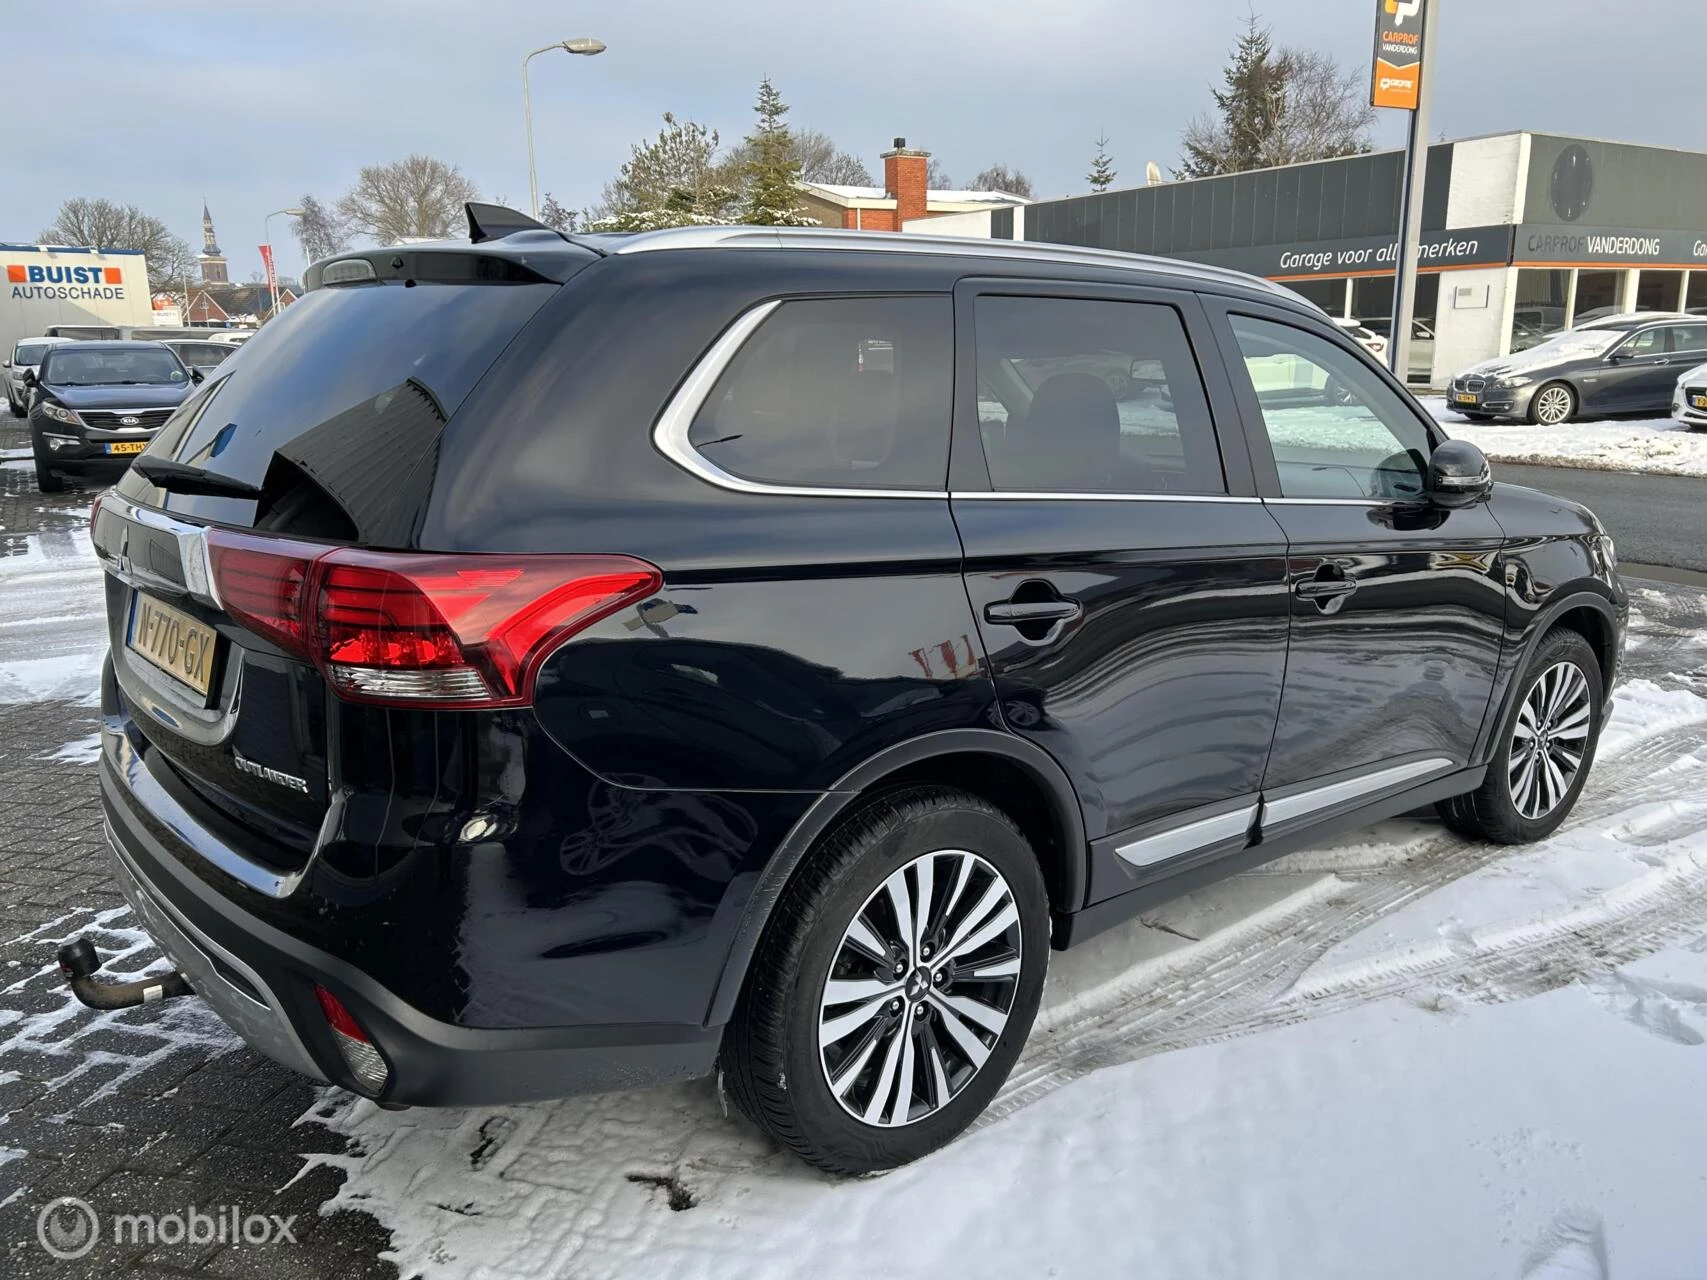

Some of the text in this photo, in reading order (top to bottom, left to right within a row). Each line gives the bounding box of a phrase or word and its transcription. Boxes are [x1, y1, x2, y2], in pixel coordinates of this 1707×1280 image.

[1383, 31, 1418, 45] CARPROF
[1528, 235, 1660, 255] CARPROF VANDERDONG
[1280, 252, 1332, 270] Garage
[1337, 248, 1372, 264] voor
[1376, 243, 1398, 262] all
[28, 265, 103, 284] BUIST
[12, 286, 124, 300] AUTOSCHADE
[138, 603, 210, 683] N-770-GX
[234, 756, 308, 793] OUTLANDER
